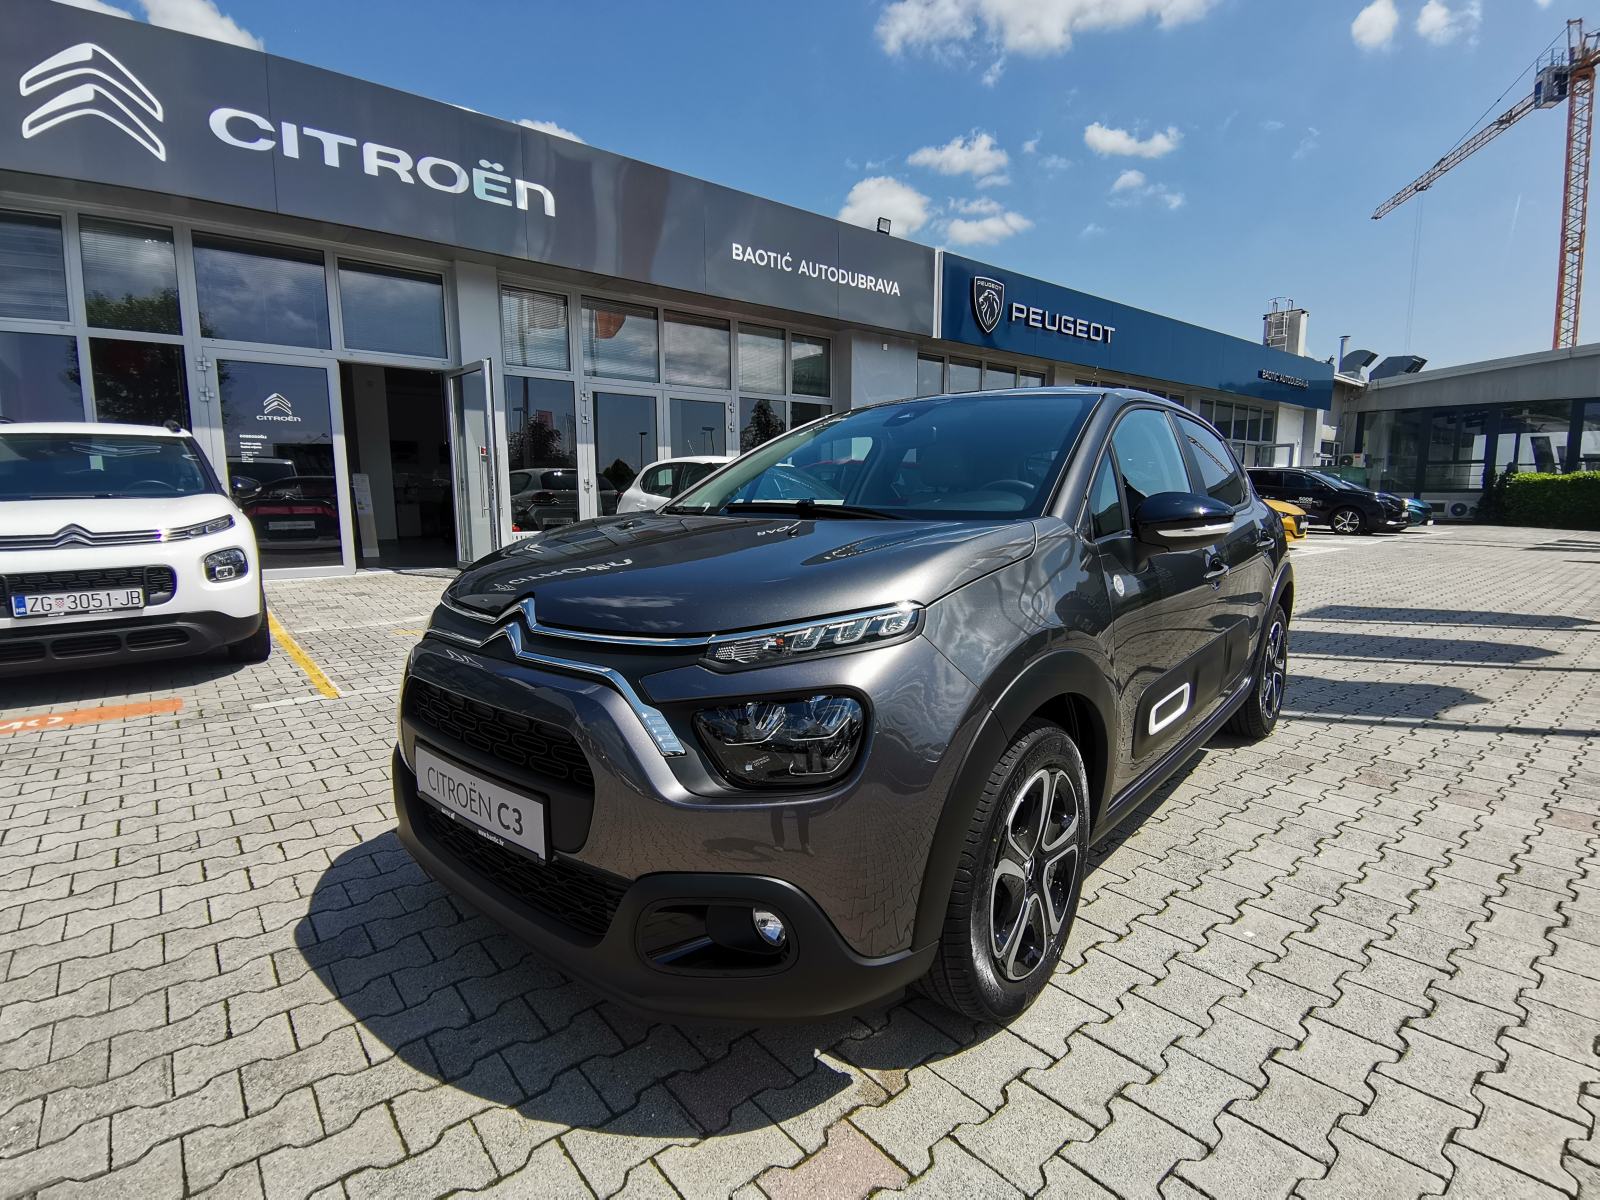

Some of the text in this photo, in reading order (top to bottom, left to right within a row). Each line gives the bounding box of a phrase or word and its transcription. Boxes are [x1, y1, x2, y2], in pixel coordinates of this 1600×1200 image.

[731, 242, 901, 297] BAOTIĆ AUTODUBRAVA
[977, 280, 1003, 291] PEUGEOT
[1011, 302, 1116, 344] PEUGEOT
[28, 596, 53, 613] ZG
[427, 766, 523, 836] CITROËN C3
